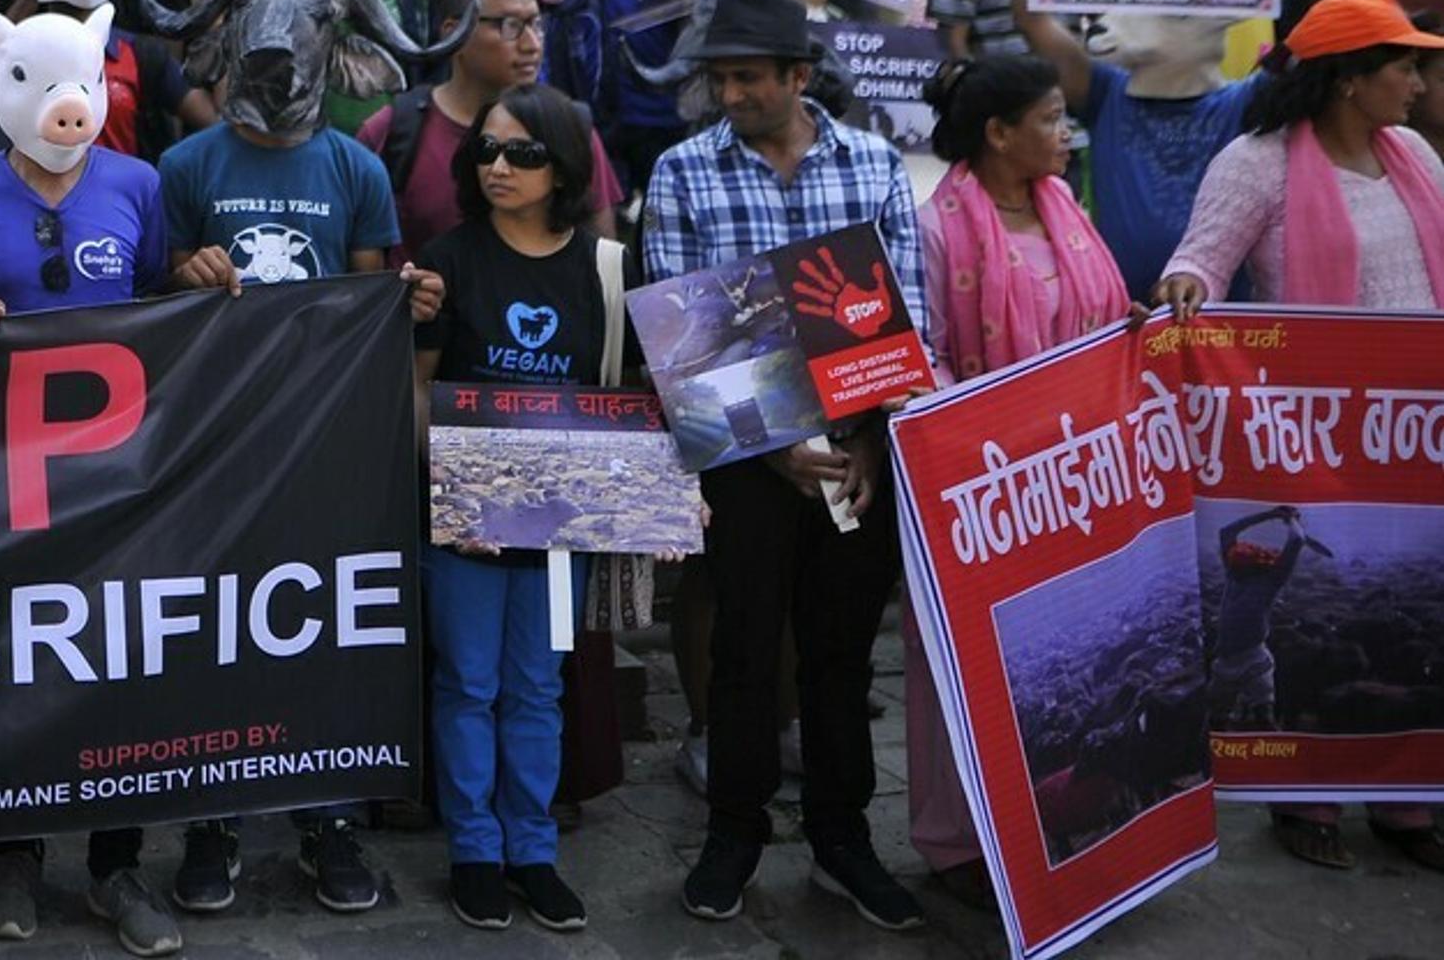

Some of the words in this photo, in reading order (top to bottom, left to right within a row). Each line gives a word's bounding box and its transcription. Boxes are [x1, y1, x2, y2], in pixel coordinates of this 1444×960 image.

[834, 31, 885, 53] STOP
[850, 55, 942, 79] SACRIFIC
[853, 78, 924, 100] DHIMAI
[214, 198, 266, 215] FUTURE
[269, 199, 286, 213] IS
[288, 200, 331, 217] VEGAN
[843, 298, 884, 325] STOP!
[487, 344, 573, 376] VEGAN
[827, 361, 858, 379] LONG
[858, 346, 911, 370] DISTANCE
[831, 368, 924, 403] TRANSPORTATION
[841, 372, 865, 389] LIVE
[866, 362, 907, 381] ANIMAL
[455, 388, 479, 413] म
[1125, 369, 1192, 509] हुने
[1180, 381, 1231, 486] शु
[1241, 368, 1352, 475] संहार
[78, 728, 240, 771] SUPPORTED
[247, 723, 288, 749] BY:
[79, 766, 194, 801] SOCIETY
[201, 744, 411, 786] INTERNATIONAL
